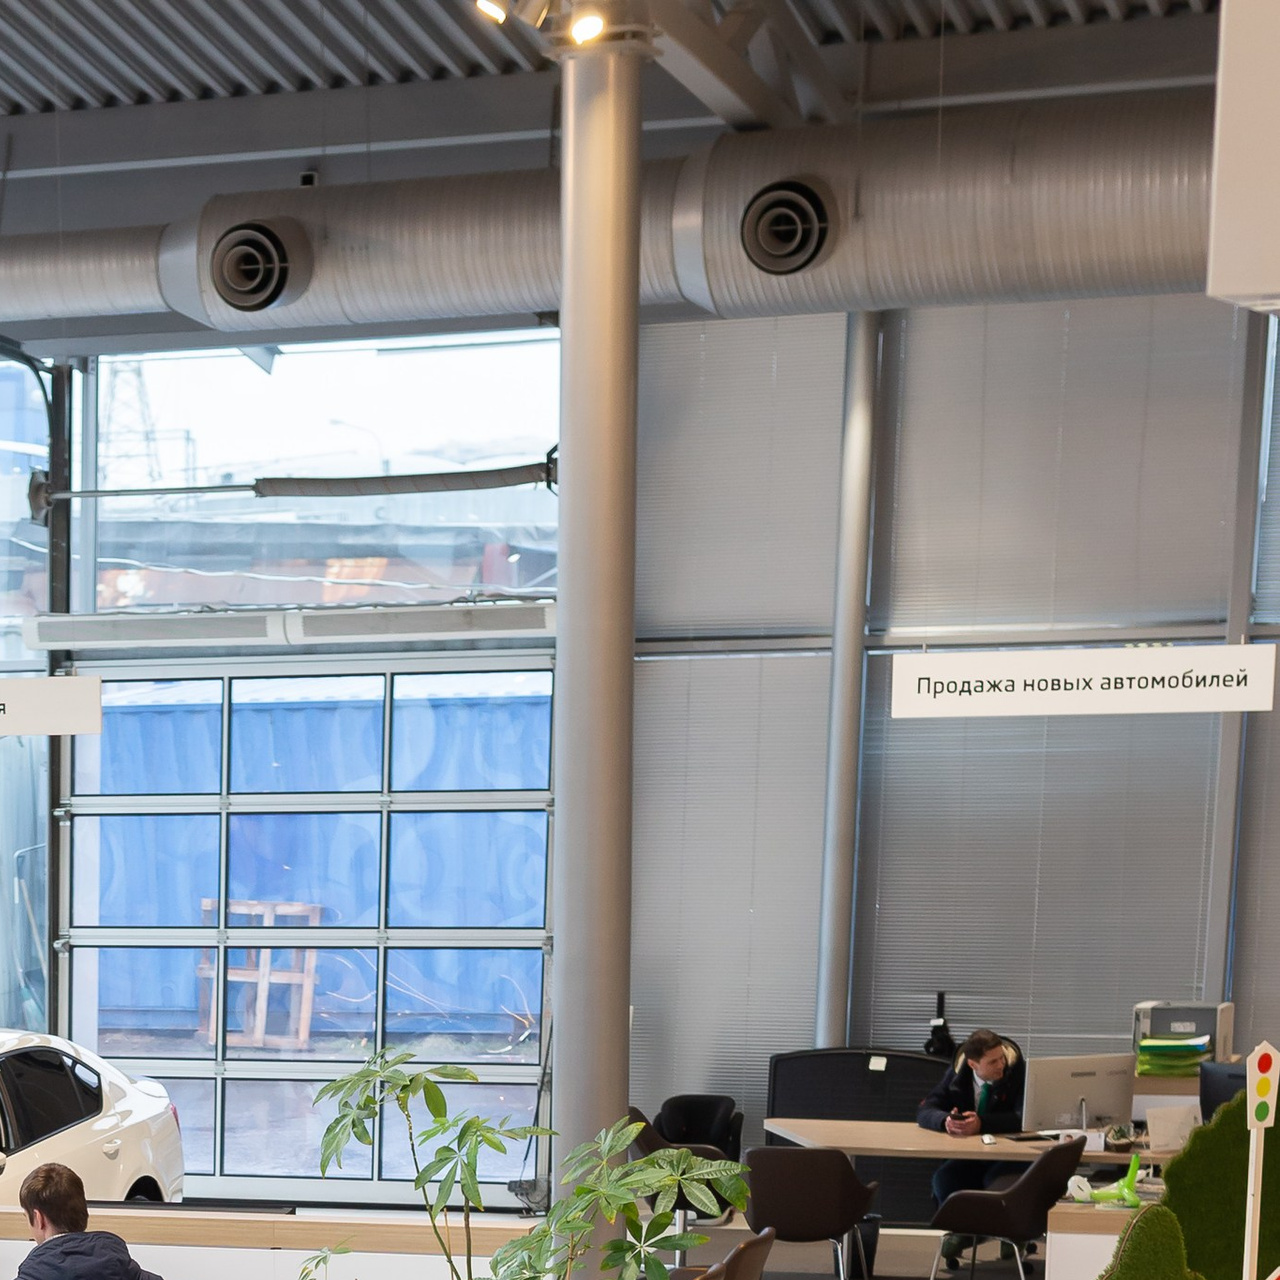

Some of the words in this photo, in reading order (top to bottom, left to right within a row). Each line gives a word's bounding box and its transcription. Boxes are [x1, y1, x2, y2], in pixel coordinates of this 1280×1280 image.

[917, 677, 1015, 698] Продажа
[1023, 676, 1093, 692] новых
[1100, 669, 1248, 690] автомобилей
